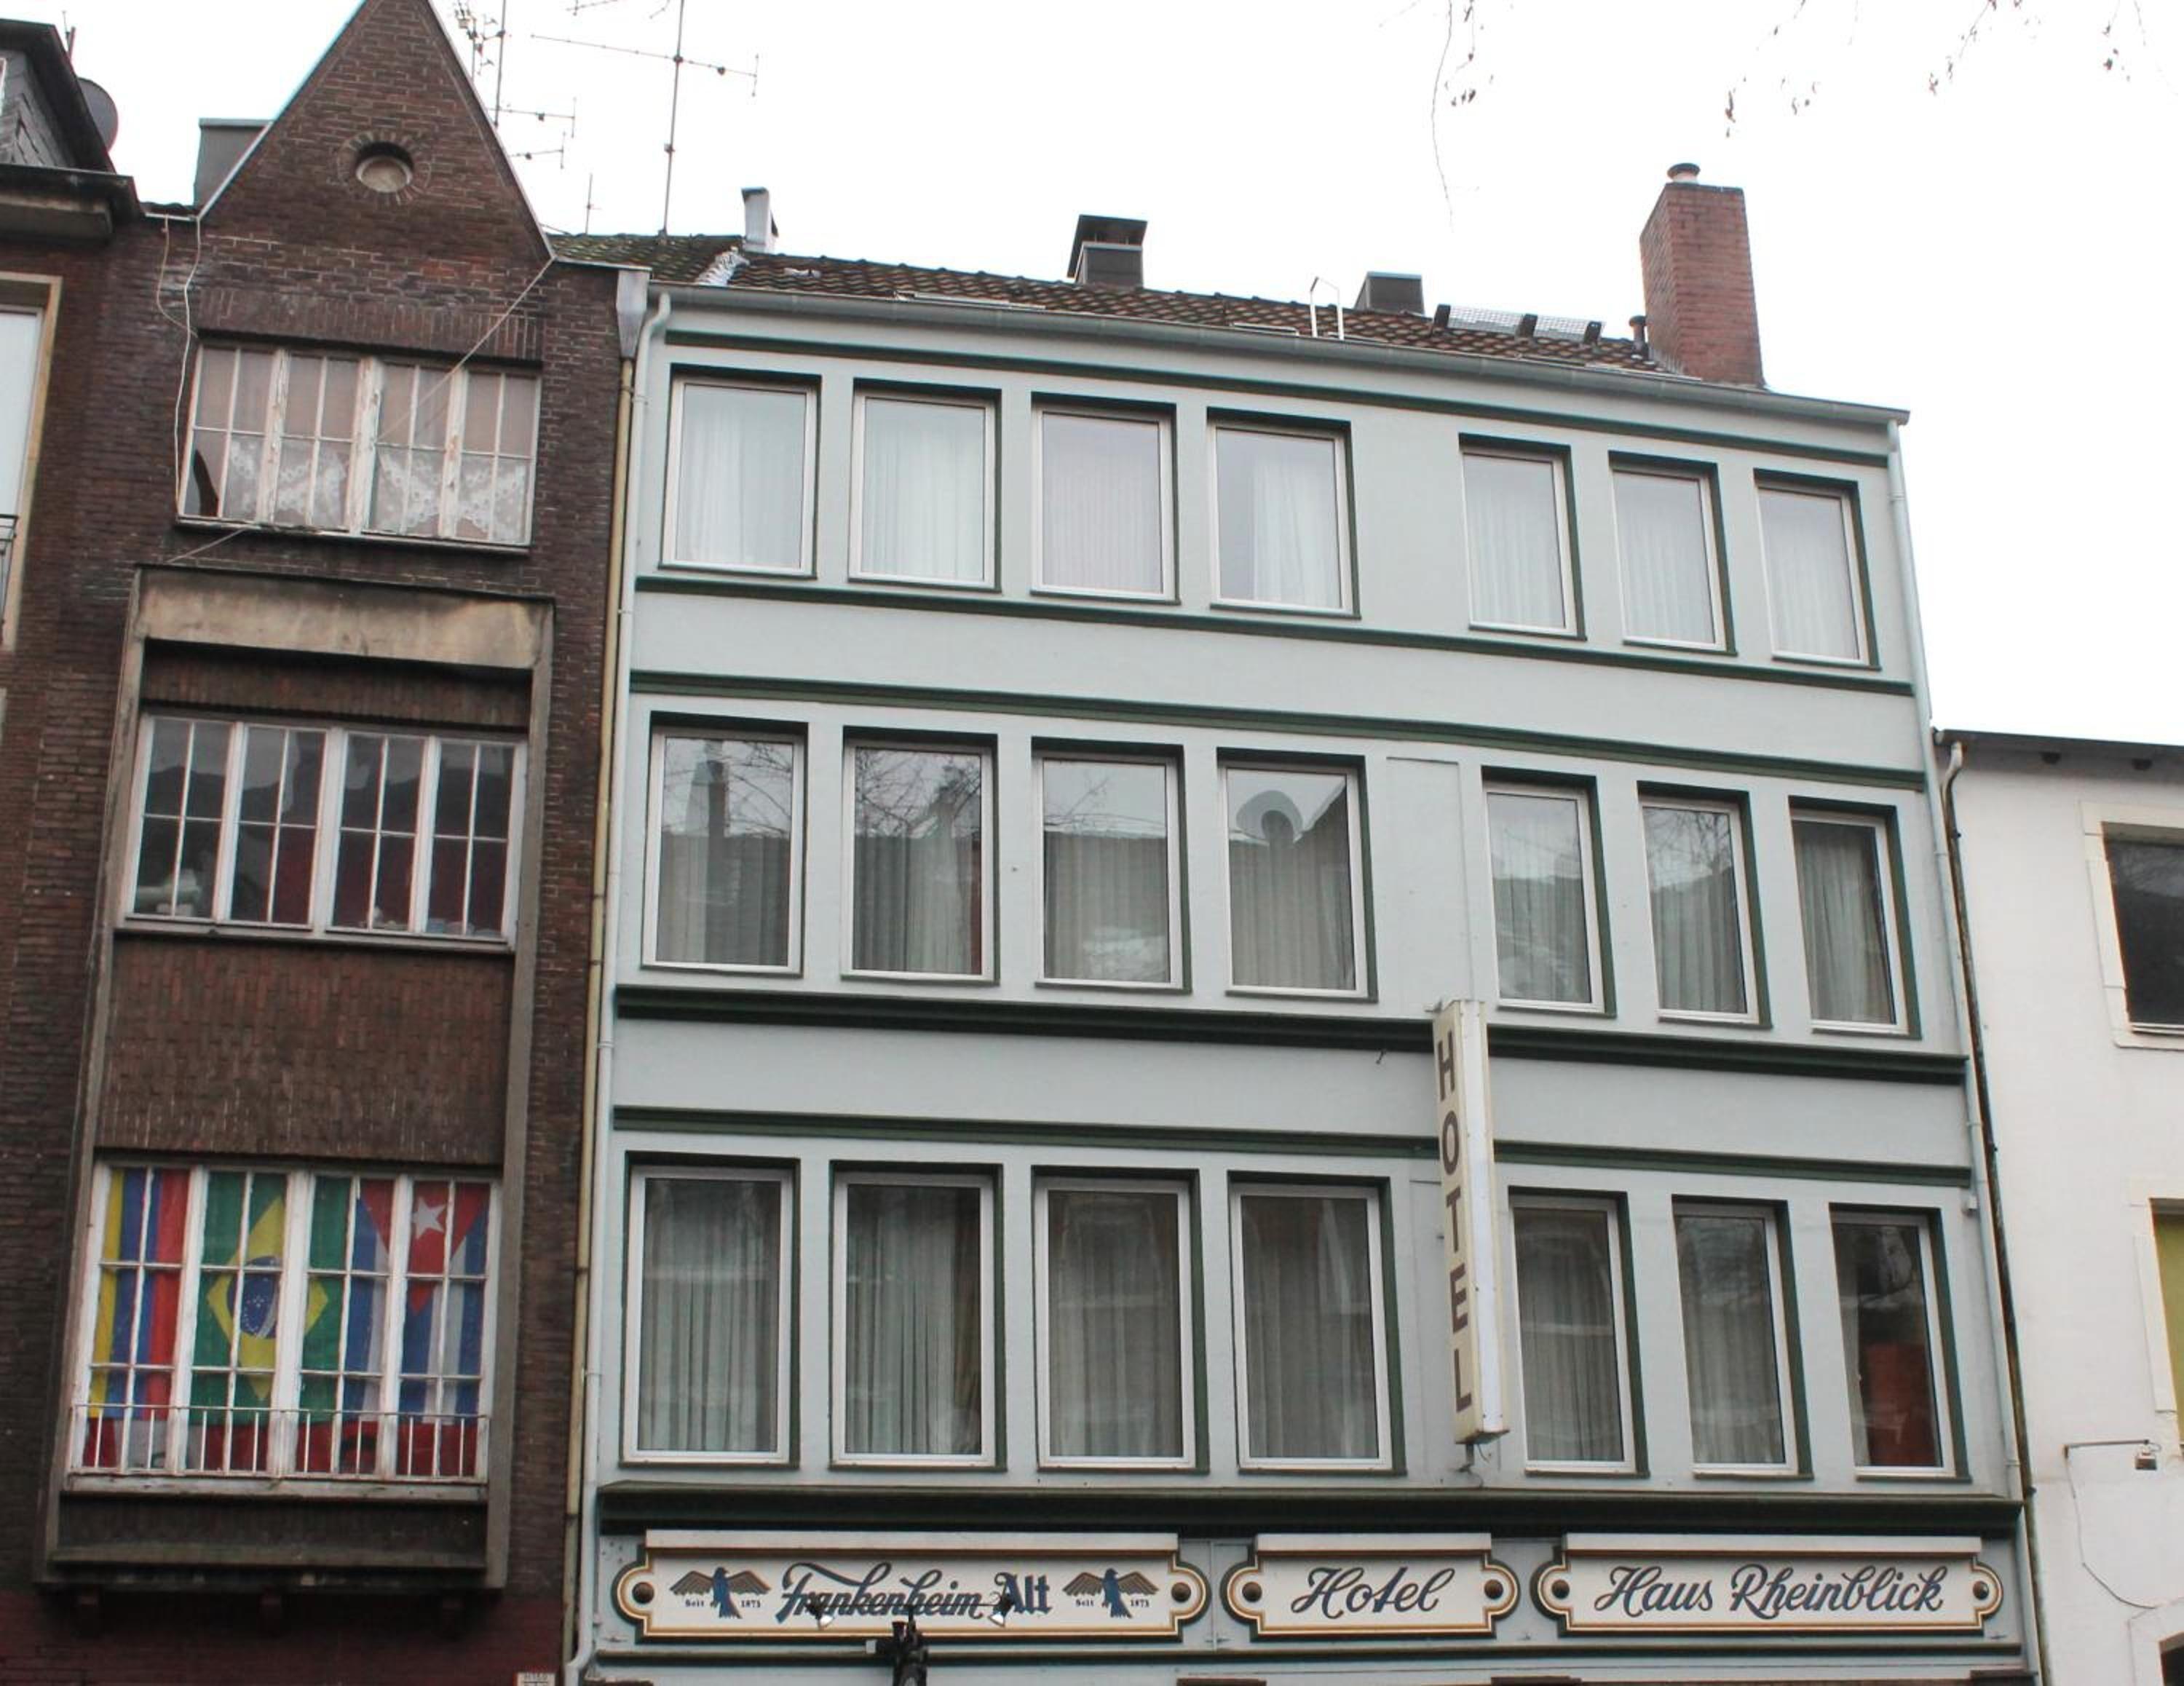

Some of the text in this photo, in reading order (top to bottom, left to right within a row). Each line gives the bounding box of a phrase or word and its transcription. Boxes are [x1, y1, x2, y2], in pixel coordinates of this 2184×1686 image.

[1437, 1030, 1472, 1412] HOTEL
[775, 1562, 1053, 1624] Frankenheim Alt
[1291, 1567, 1455, 1619] Hotel
[1594, 1563, 1949, 1620] Haus Rheinblick
